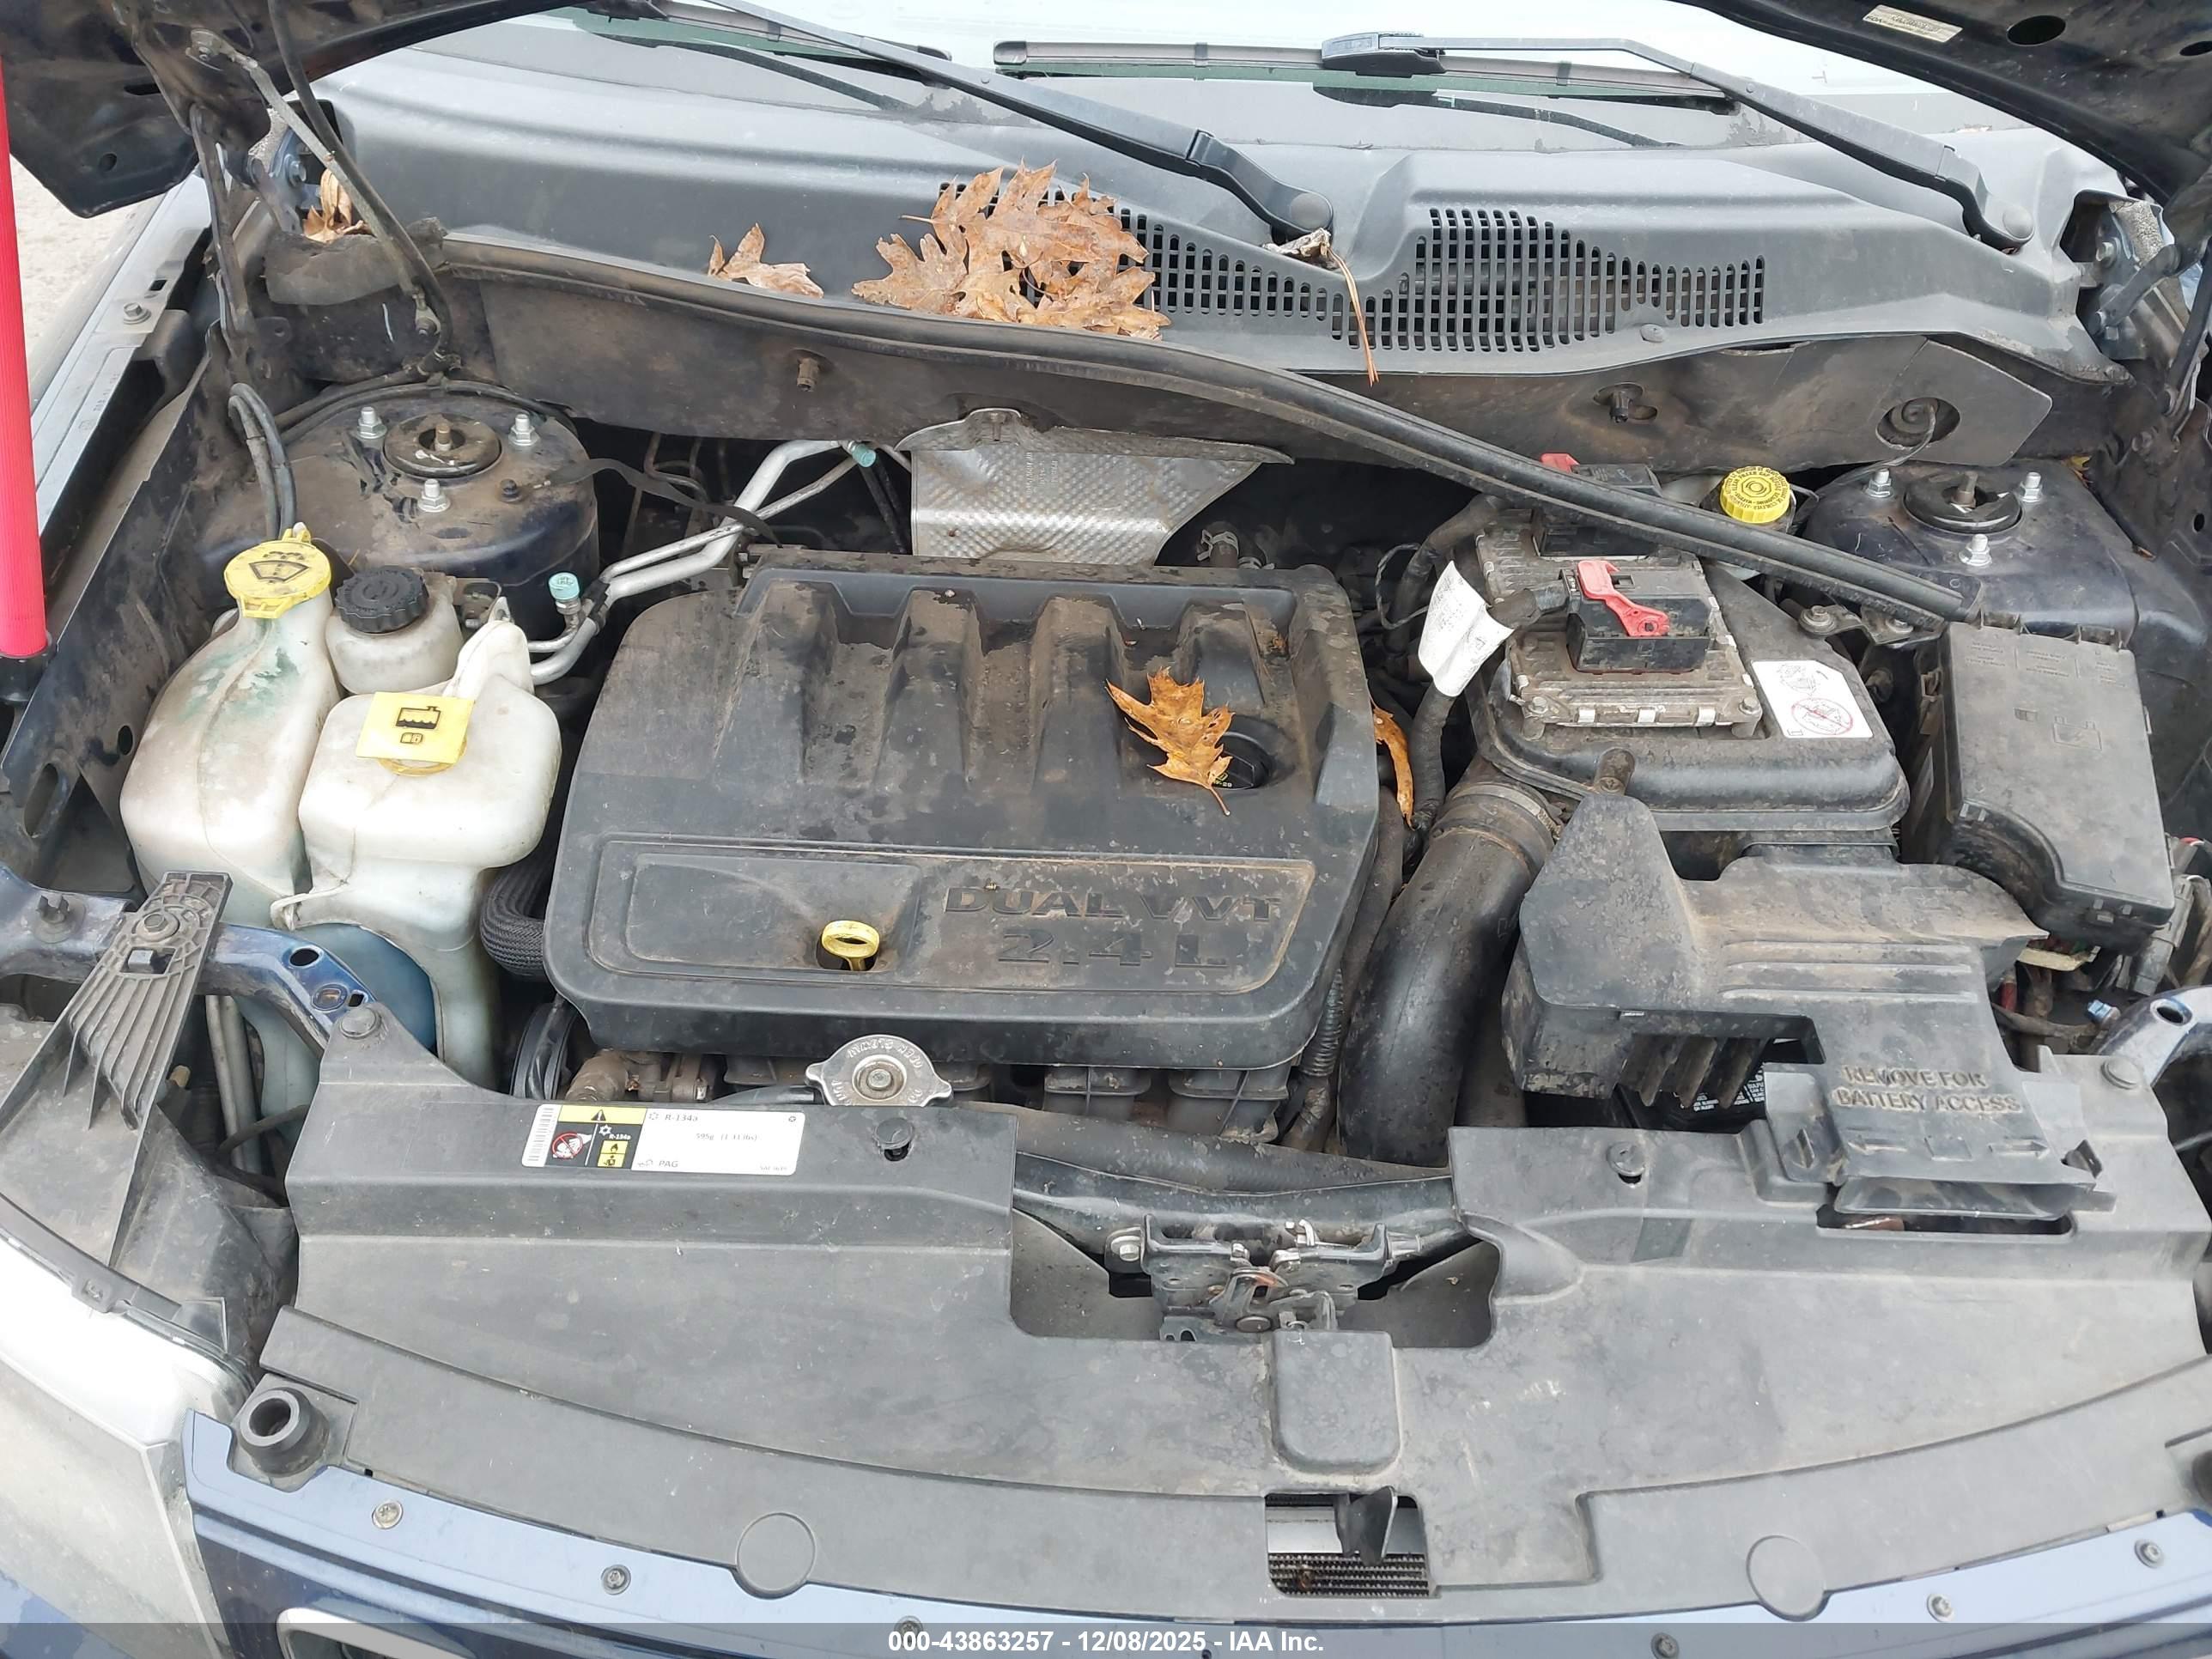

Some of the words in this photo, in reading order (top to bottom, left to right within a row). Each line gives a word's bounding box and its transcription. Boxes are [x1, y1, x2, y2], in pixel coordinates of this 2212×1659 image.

[944, 887, 1124, 918] DUAL
[1140, 895, 1281, 922] VVT
[1844, 1066, 1935, 1088] REMOVE
[1938, 1071, 1987, 1088] FOR
[1835, 1087, 1927, 1112] BATTERY
[1935, 1094, 2022, 1113] ACCESS
[665, 1114, 698, 1122] R-134a
